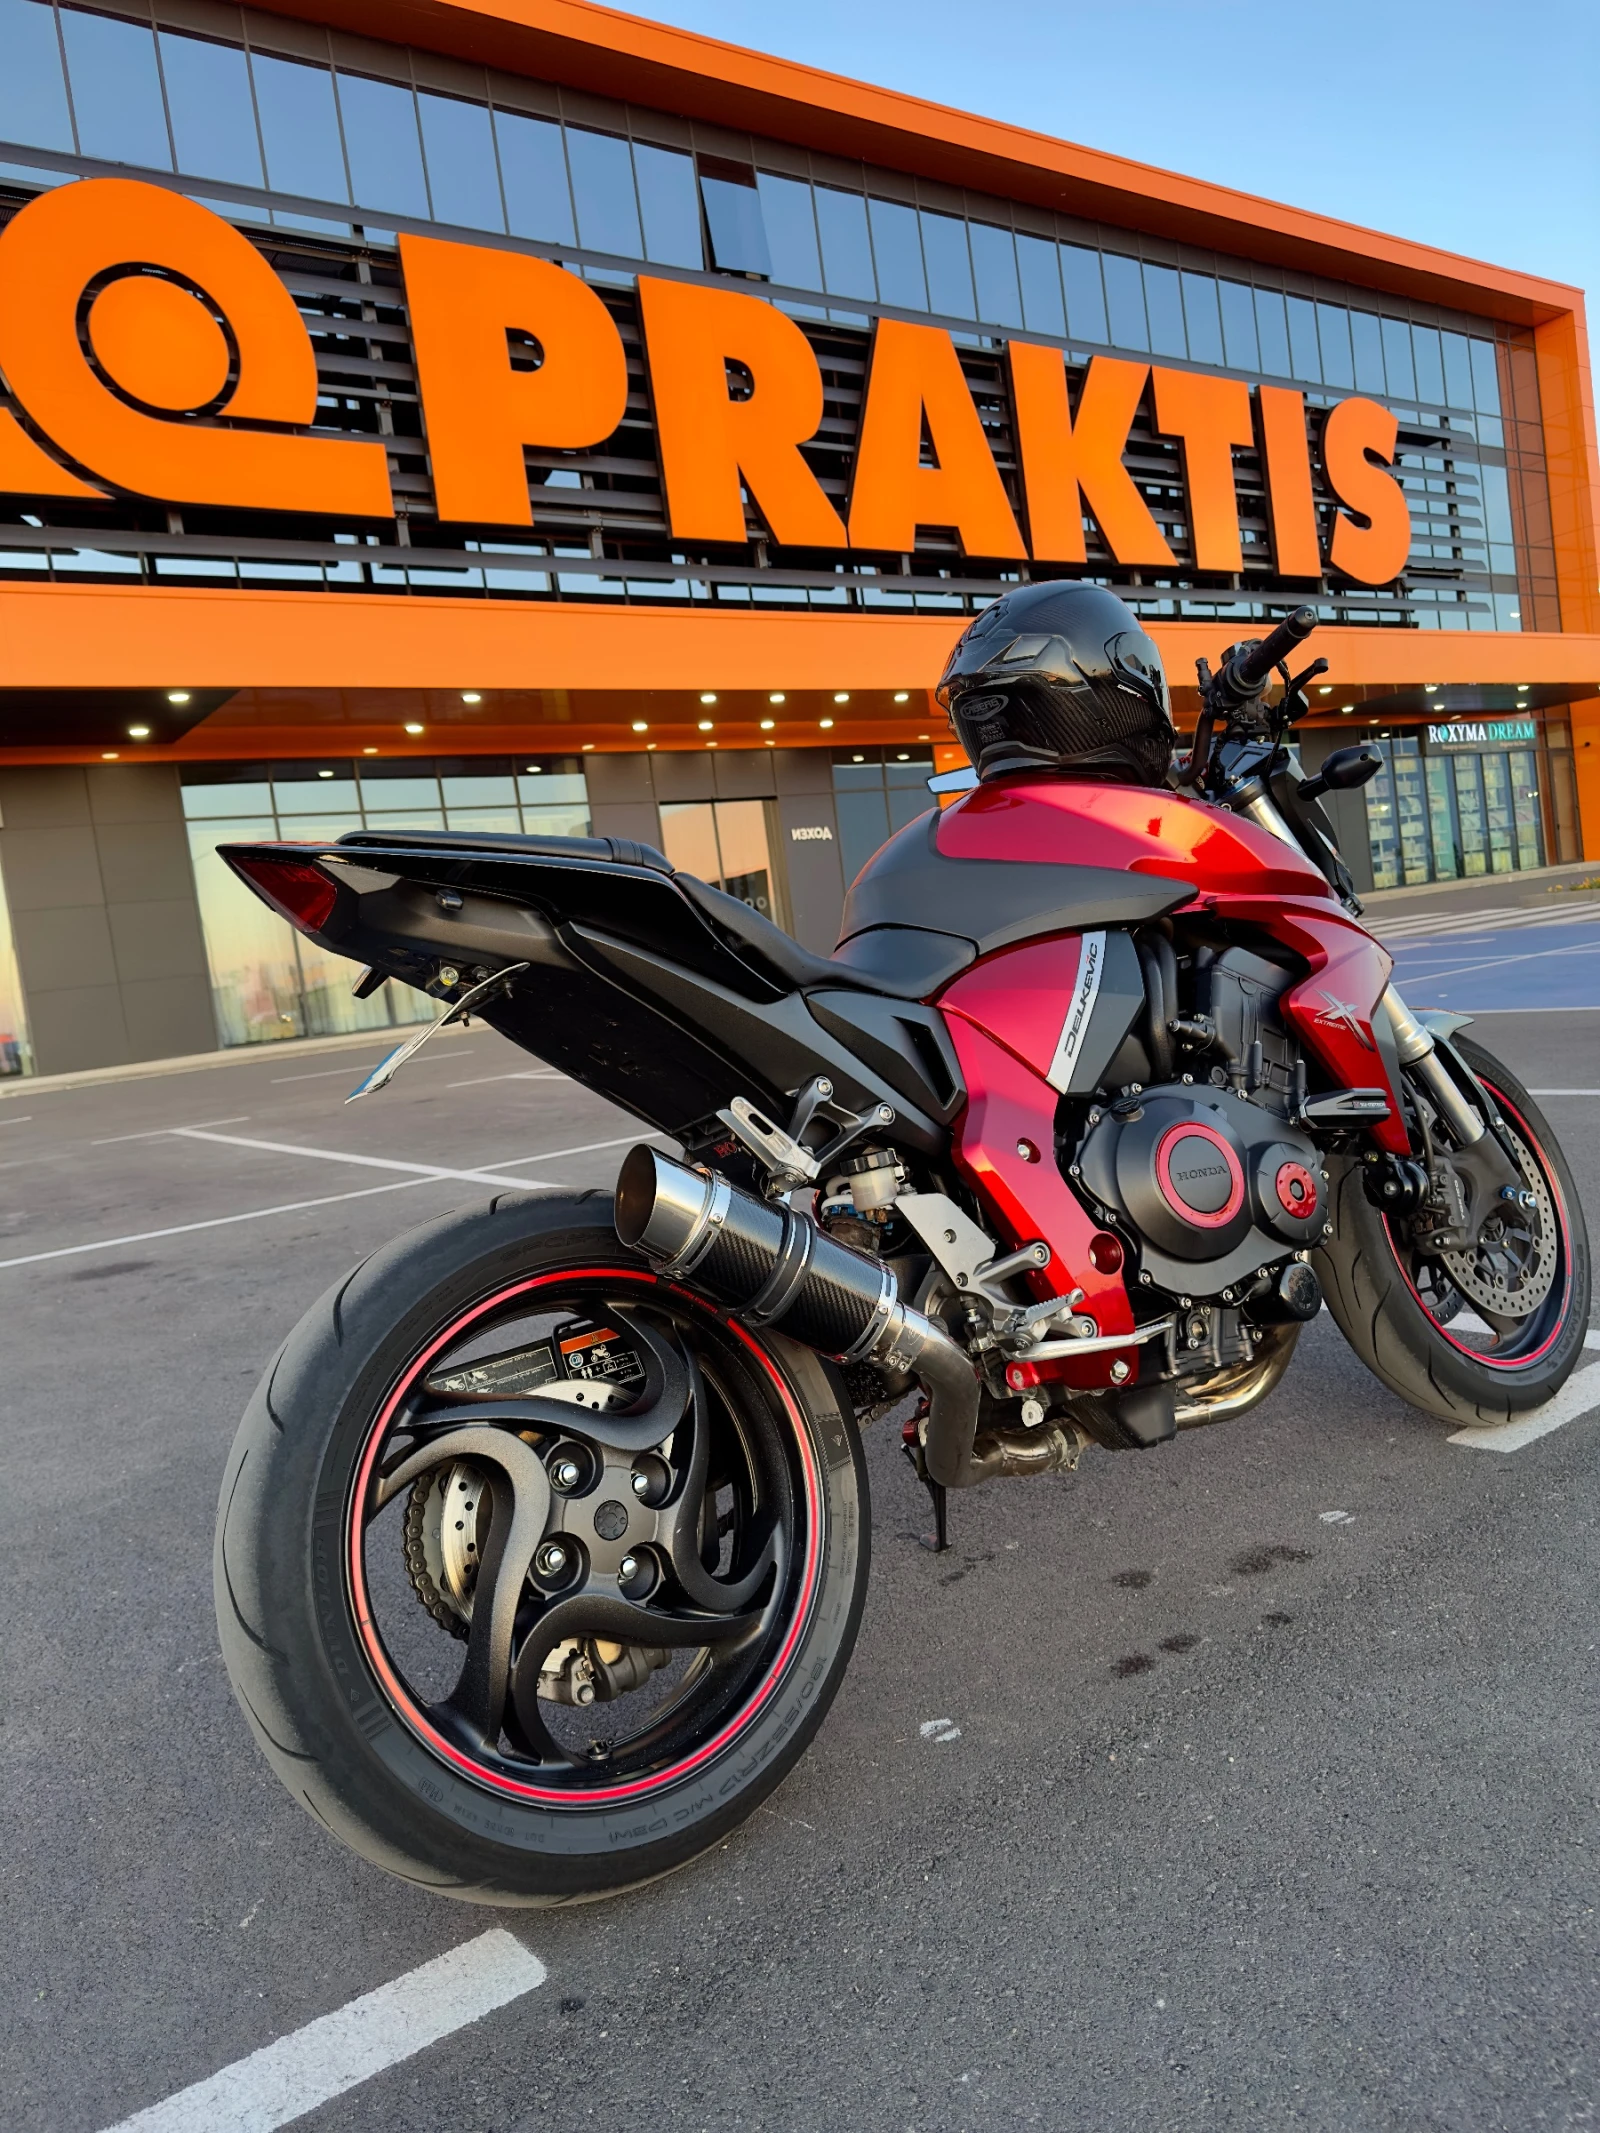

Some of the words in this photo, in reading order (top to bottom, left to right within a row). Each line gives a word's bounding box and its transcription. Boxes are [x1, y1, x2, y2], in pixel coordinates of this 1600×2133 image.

[397, 232, 1411, 585] PRAKTIS
[1428, 723, 1487, 743] ROXYMA
[1488, 722, 1535, 741] DREAM
[791, 826, 832, 841] ИЗХОД
[1064, 942, 1098, 1058] DELKEVIC
[1313, 1018, 1347, 1031] EXTREME
[1176, 1165, 1228, 1182] HONDA
[316, 1537, 349, 1675] DUNLOP
[718, 1655, 828, 1797] 180/55ZR17
